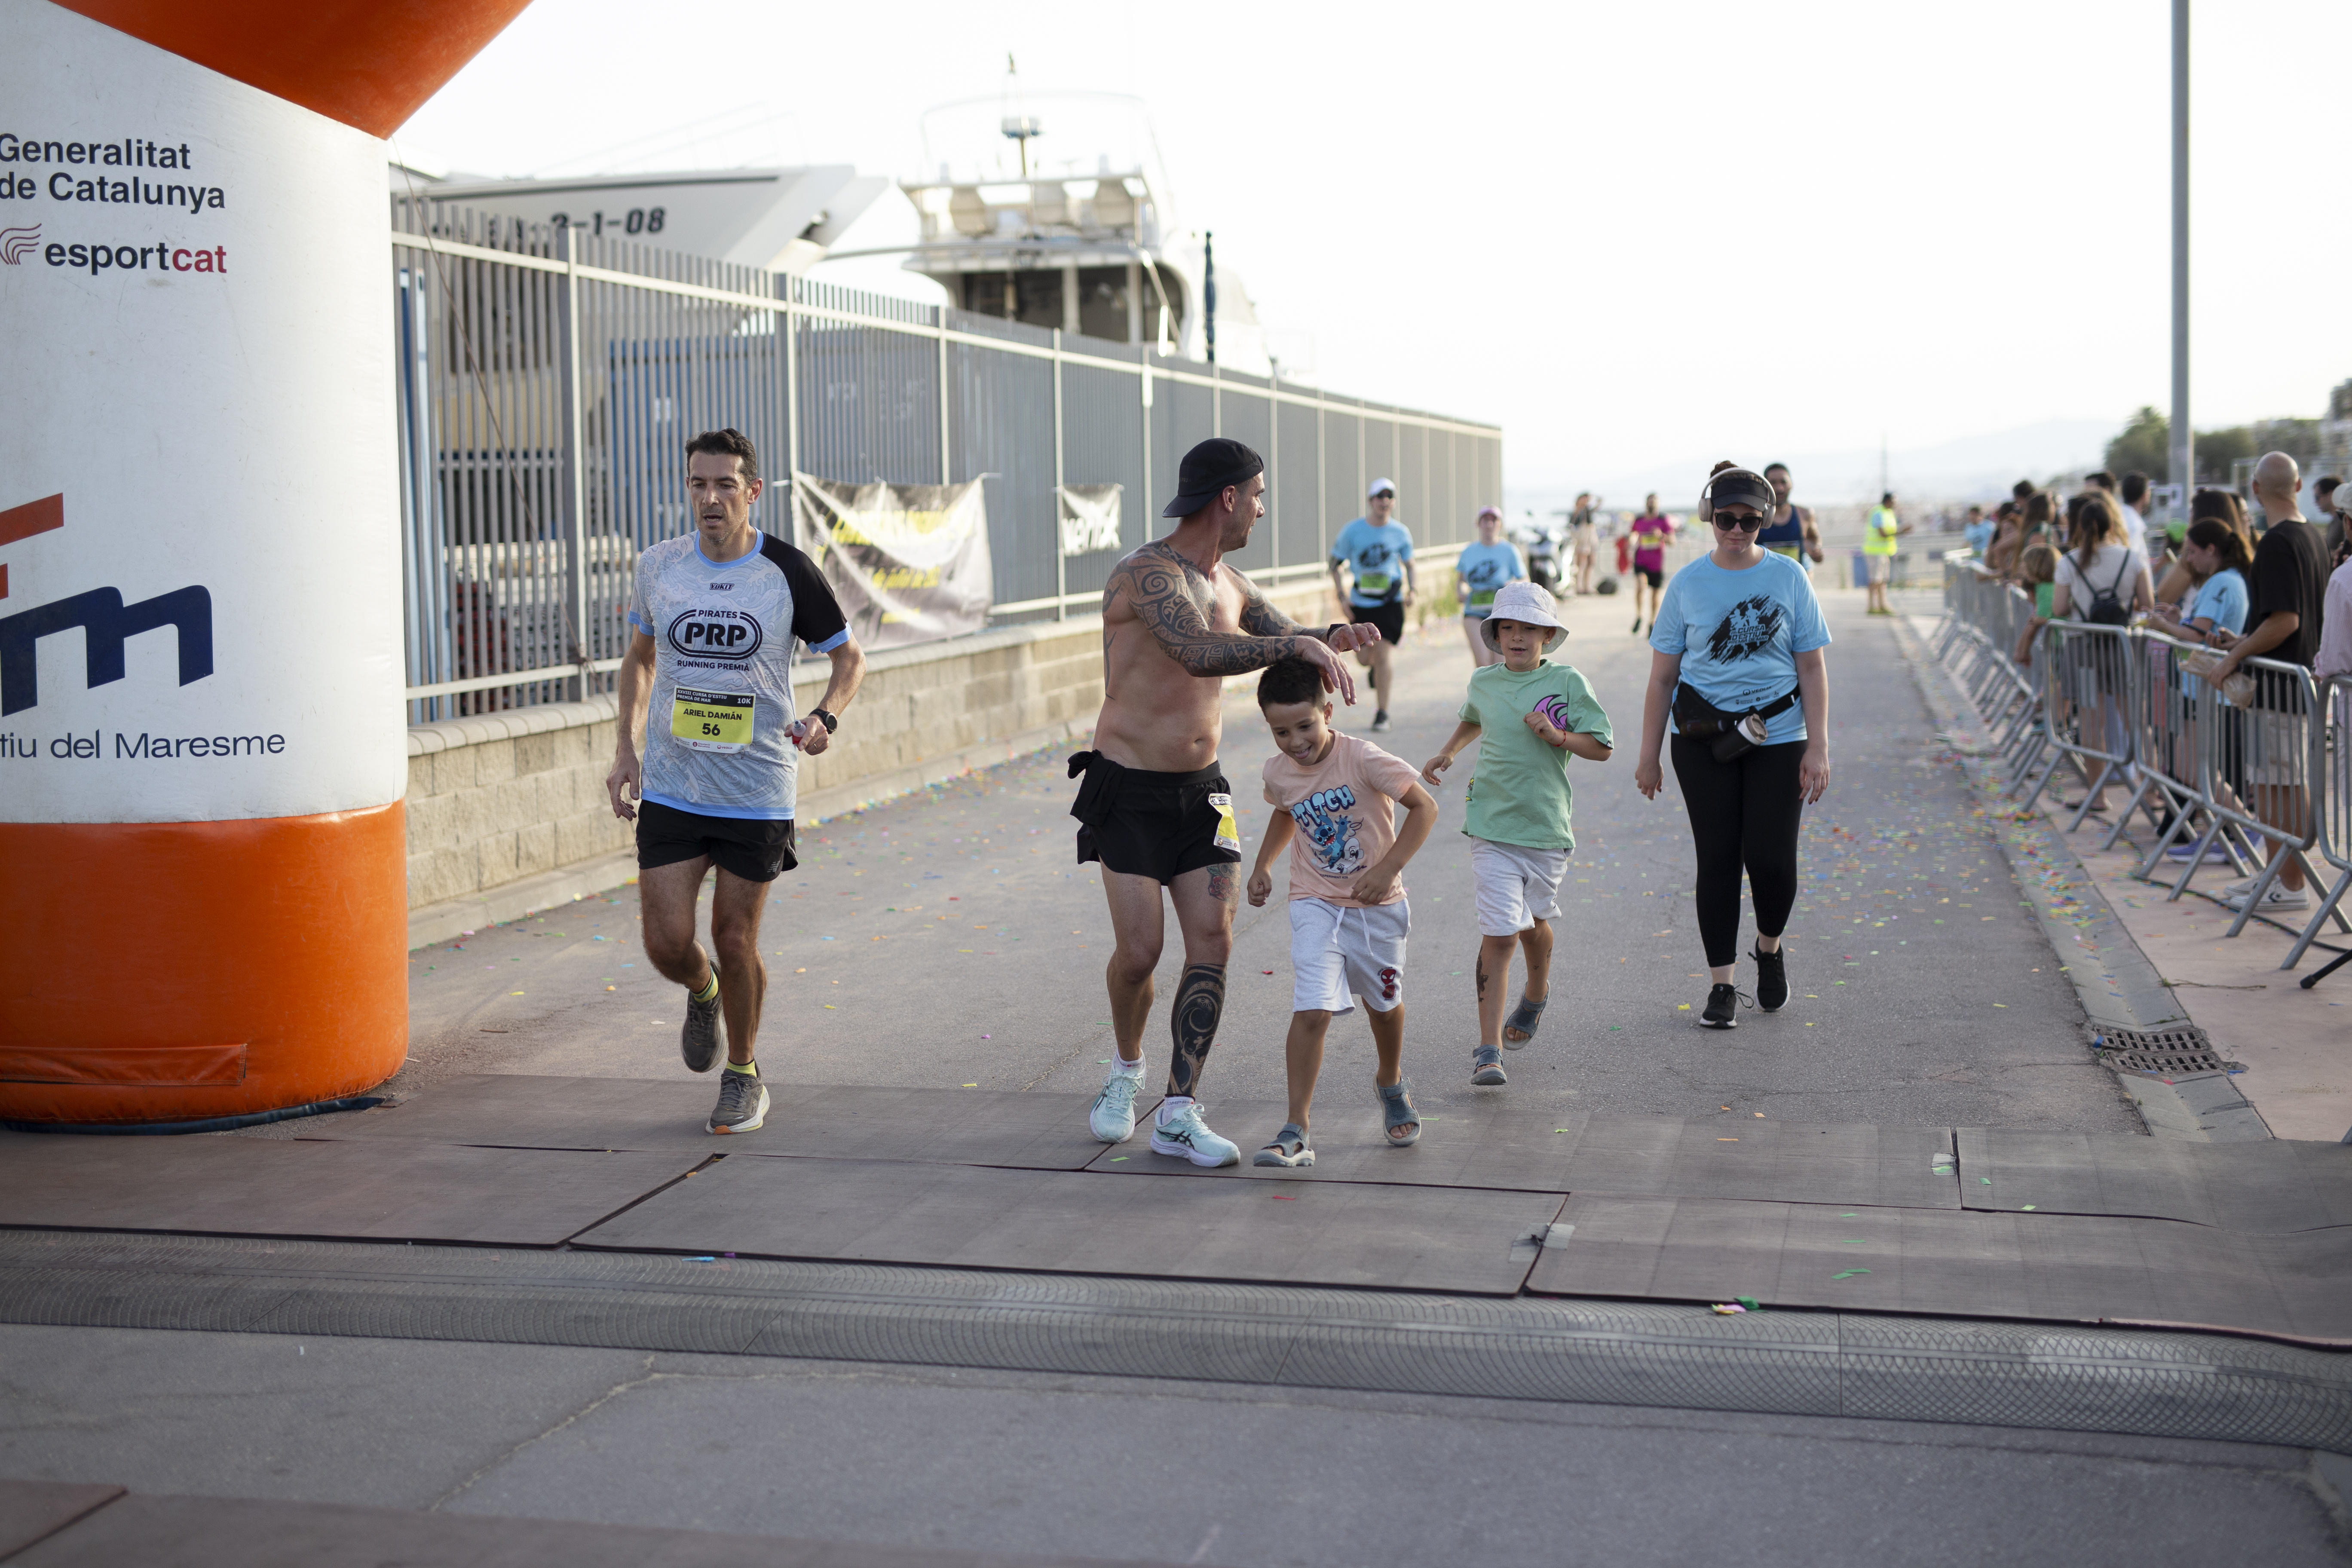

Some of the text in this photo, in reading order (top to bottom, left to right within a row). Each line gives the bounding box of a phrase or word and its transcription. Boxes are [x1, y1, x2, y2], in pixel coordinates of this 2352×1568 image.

[0, 133, 190, 169] Generalitat
[0, 172, 225, 214] de Catalunya
[45, 242, 227, 275] esportcat
[698, 610, 738, 619] PIRATES
[685, 622, 747, 646] PRP
[1738, 625, 1764, 634] CURSA
[677, 660, 749, 671] RUNNING PREMIÀ
[683, 708, 742, 720] ARIEL DAMIÁN
[701, 723, 721, 736] 56
[50, 729, 100, 759] del
[116, 733, 285, 759] Maresme
